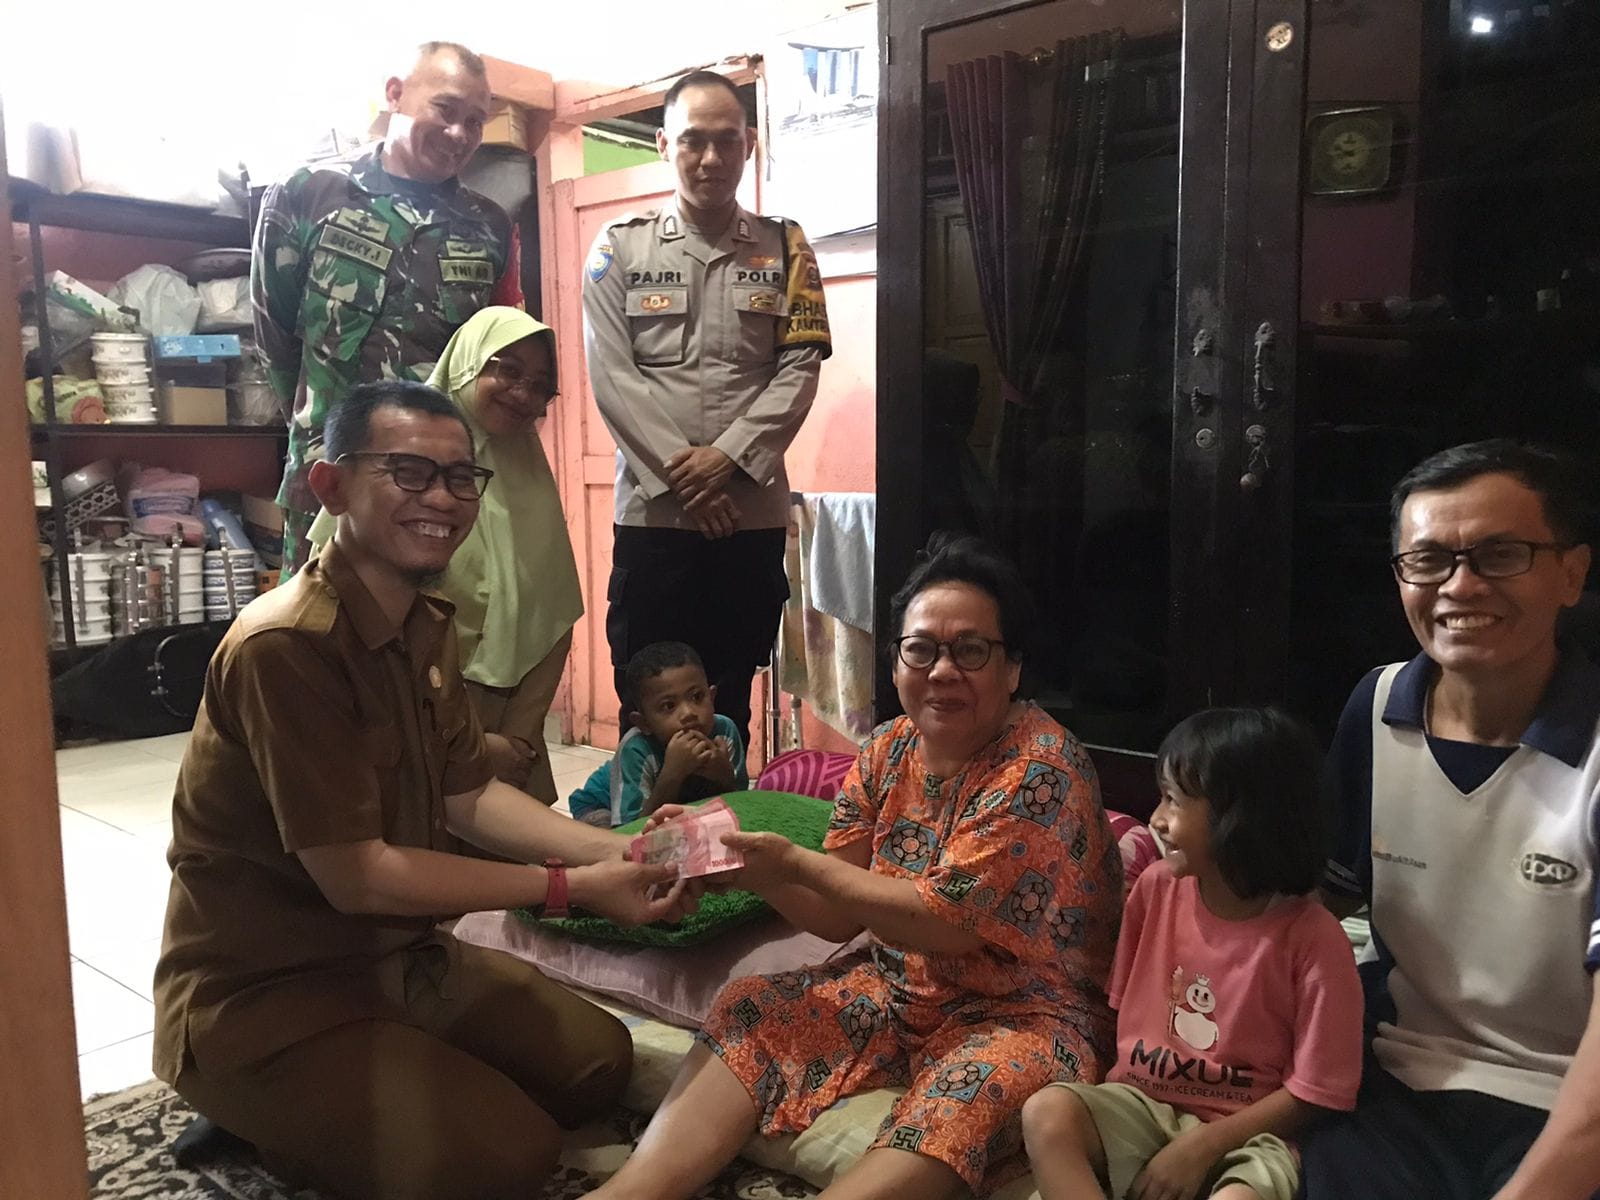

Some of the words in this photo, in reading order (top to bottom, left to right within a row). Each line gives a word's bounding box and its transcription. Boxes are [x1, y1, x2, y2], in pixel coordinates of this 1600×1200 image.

[630, 271, 682, 284] PAJRI
[1130, 1039, 1254, 1088] MIXUE
[1127, 1072, 1149, 1087] SINCE
[1152, 1082, 1168, 1092] 1997
[1174, 1085, 1189, 1095] ICE
[1190, 1086, 1225, 1099] CREAM
[1234, 1091, 1253, 1103] TEA
